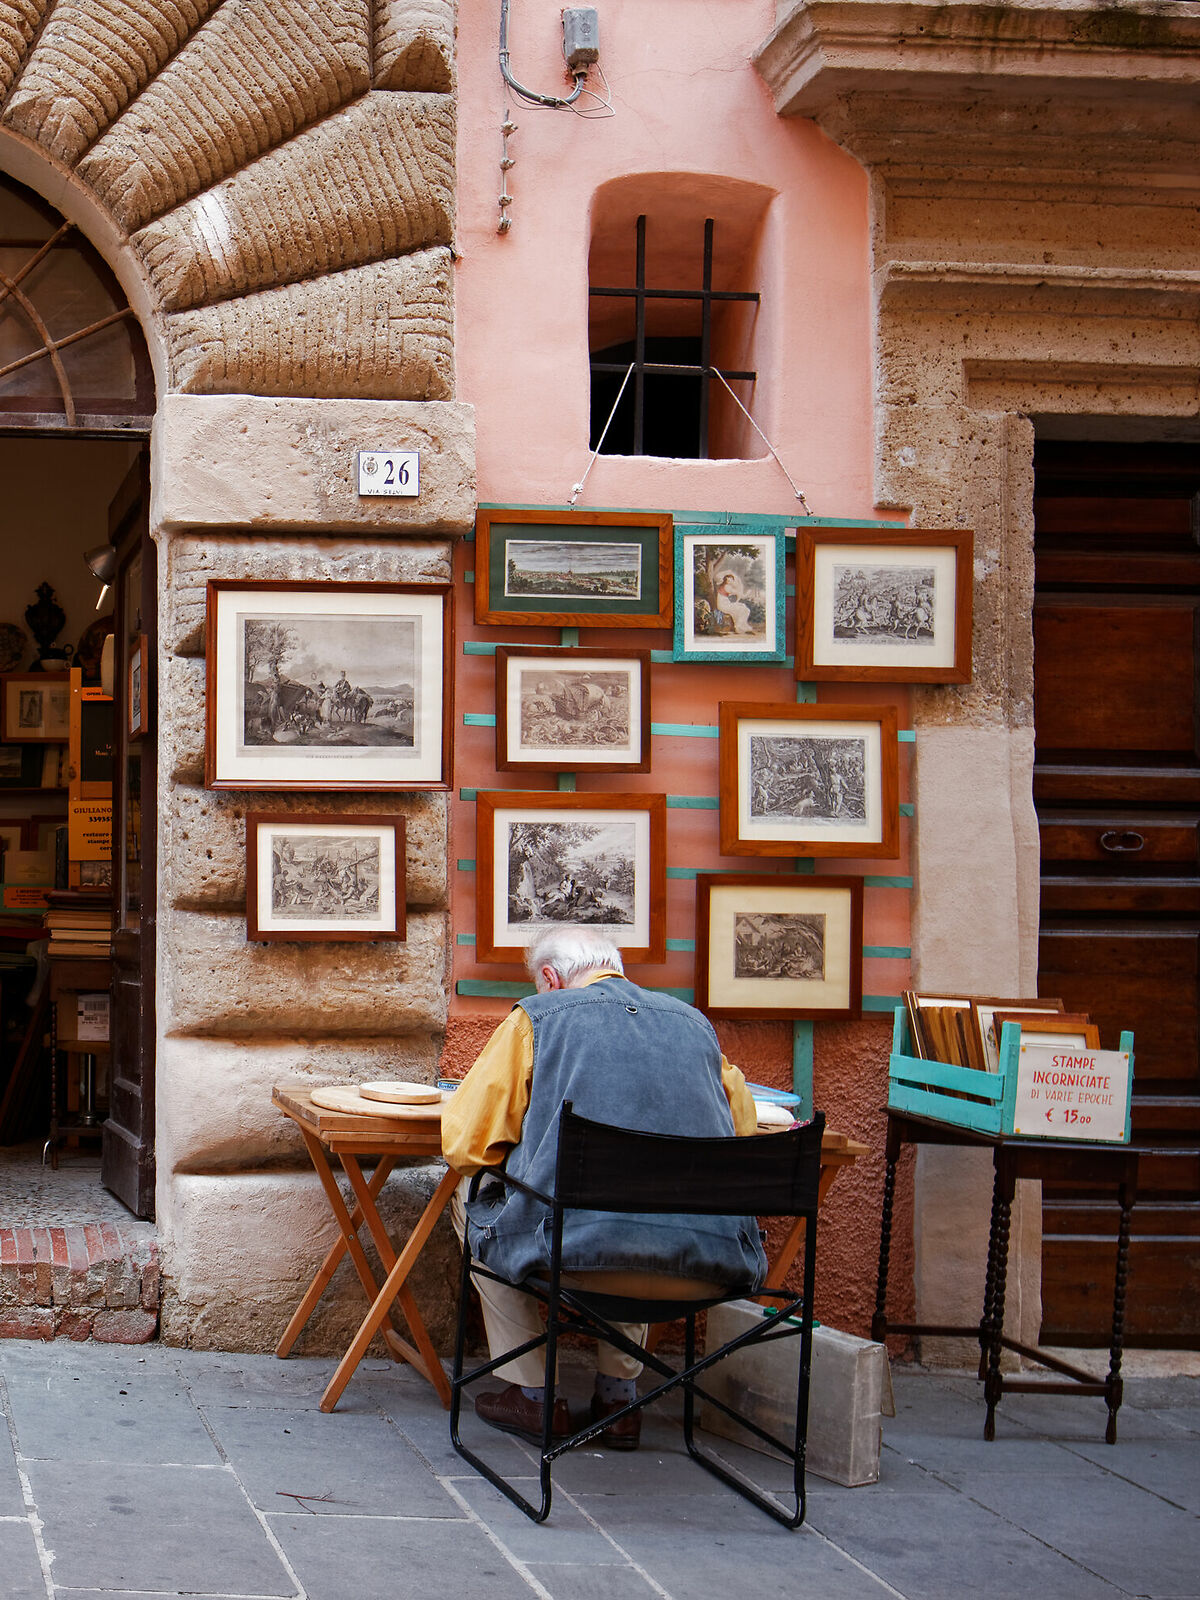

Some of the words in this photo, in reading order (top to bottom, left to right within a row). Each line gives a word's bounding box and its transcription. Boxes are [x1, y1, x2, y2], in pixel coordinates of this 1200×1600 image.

[383, 459, 410, 486] 26
[1051, 1055, 1097, 1071] STAMPE
[1033, 1071, 1111, 1090] INCORNICIATE
[1030, 1089, 1040, 1099] DI
[1045, 1089, 1074, 1103] VARIE
[1078, 1092, 1115, 1106] EPOCHE
[1045, 1107, 1055, 1123] €
